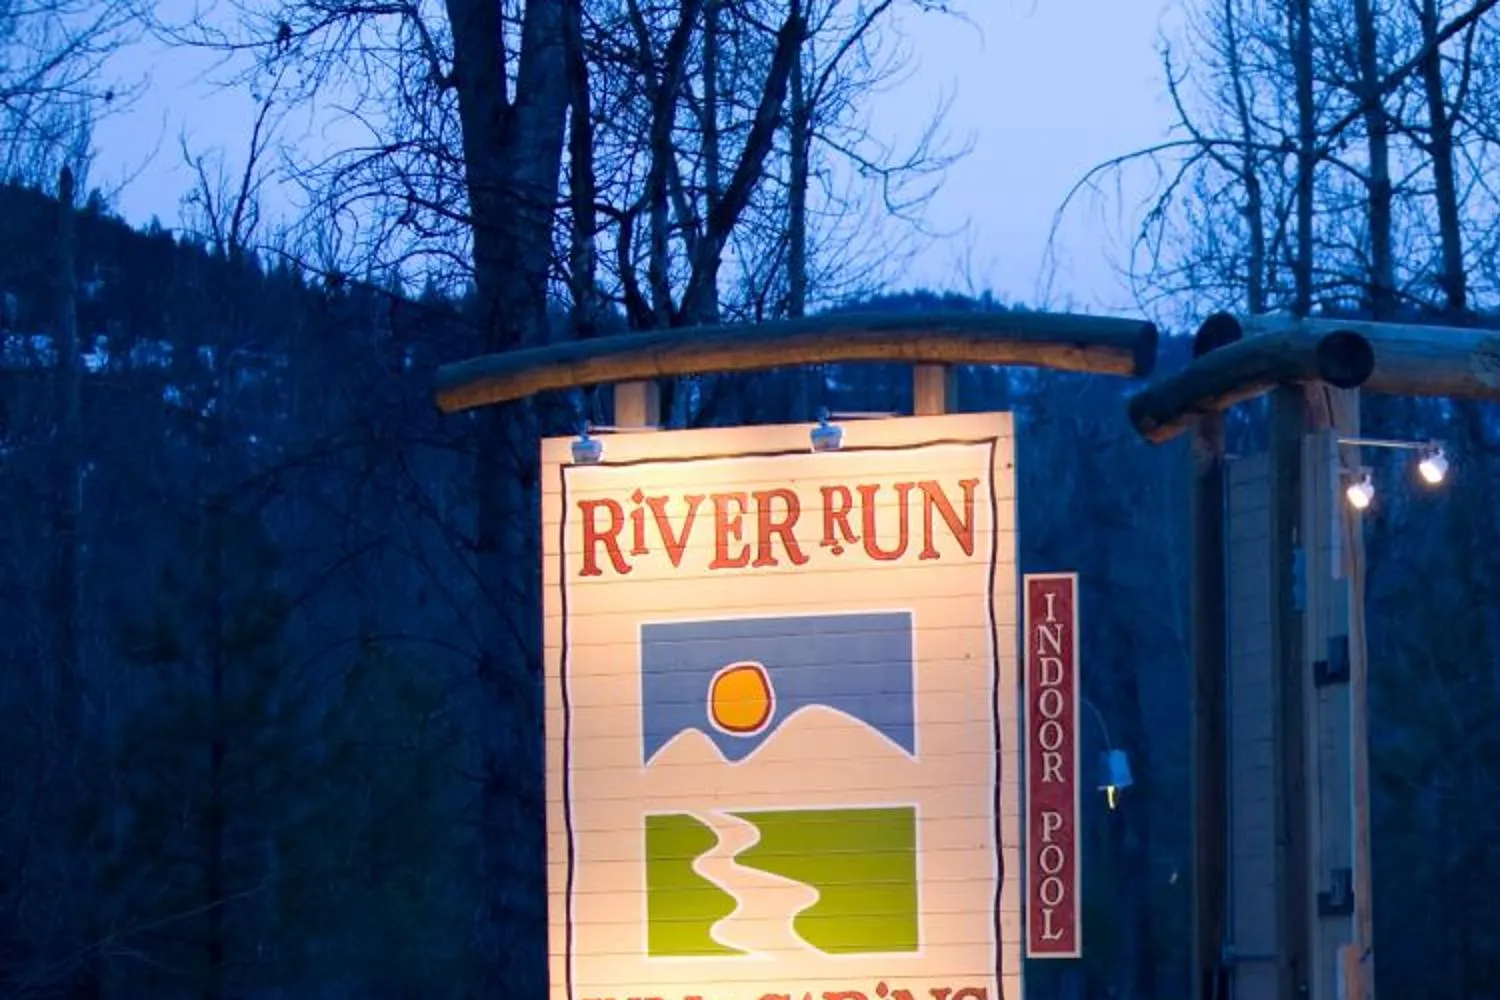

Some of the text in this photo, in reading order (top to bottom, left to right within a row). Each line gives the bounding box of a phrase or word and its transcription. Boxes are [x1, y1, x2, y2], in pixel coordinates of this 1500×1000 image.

[818, 478, 980, 562] RUN
[1036, 592, 1065, 941] INDOOR POOL
